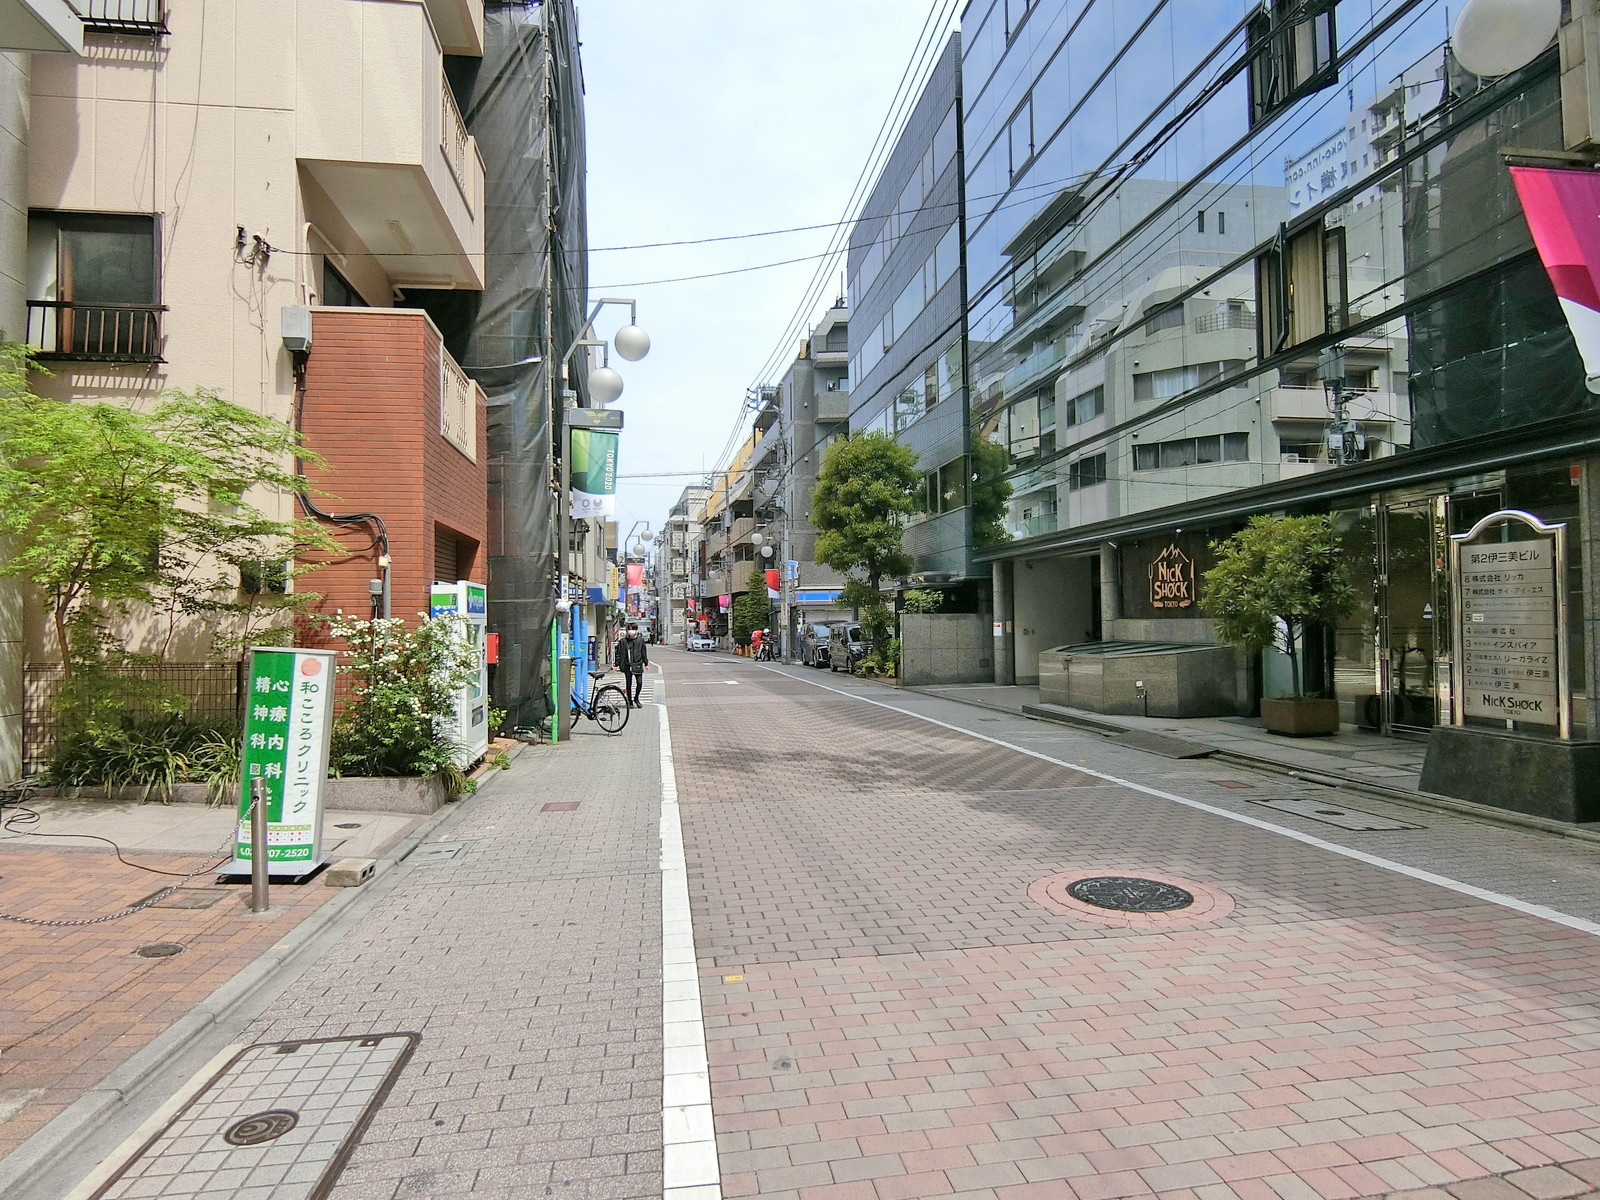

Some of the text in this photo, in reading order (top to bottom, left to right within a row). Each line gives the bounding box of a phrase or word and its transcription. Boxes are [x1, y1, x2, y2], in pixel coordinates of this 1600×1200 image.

[604, 449, 615, 490] TOKYO 2020
[1471, 550, 1540, 565] 第2伊三美ビル
[1465, 588, 1471, 596] 7
[1465, 600, 1471, 609] 6
[1465, 613, 1471, 621] 5
[1465, 639, 1471, 647] 3
[1466, 652, 1472, 661] 2
[1466, 665, 1472, 673] 2
[250, 676, 271, 750] 精神科
[264, 680, 290, 779] 心療内科
[293, 681, 319, 814] 和こころクリニック
